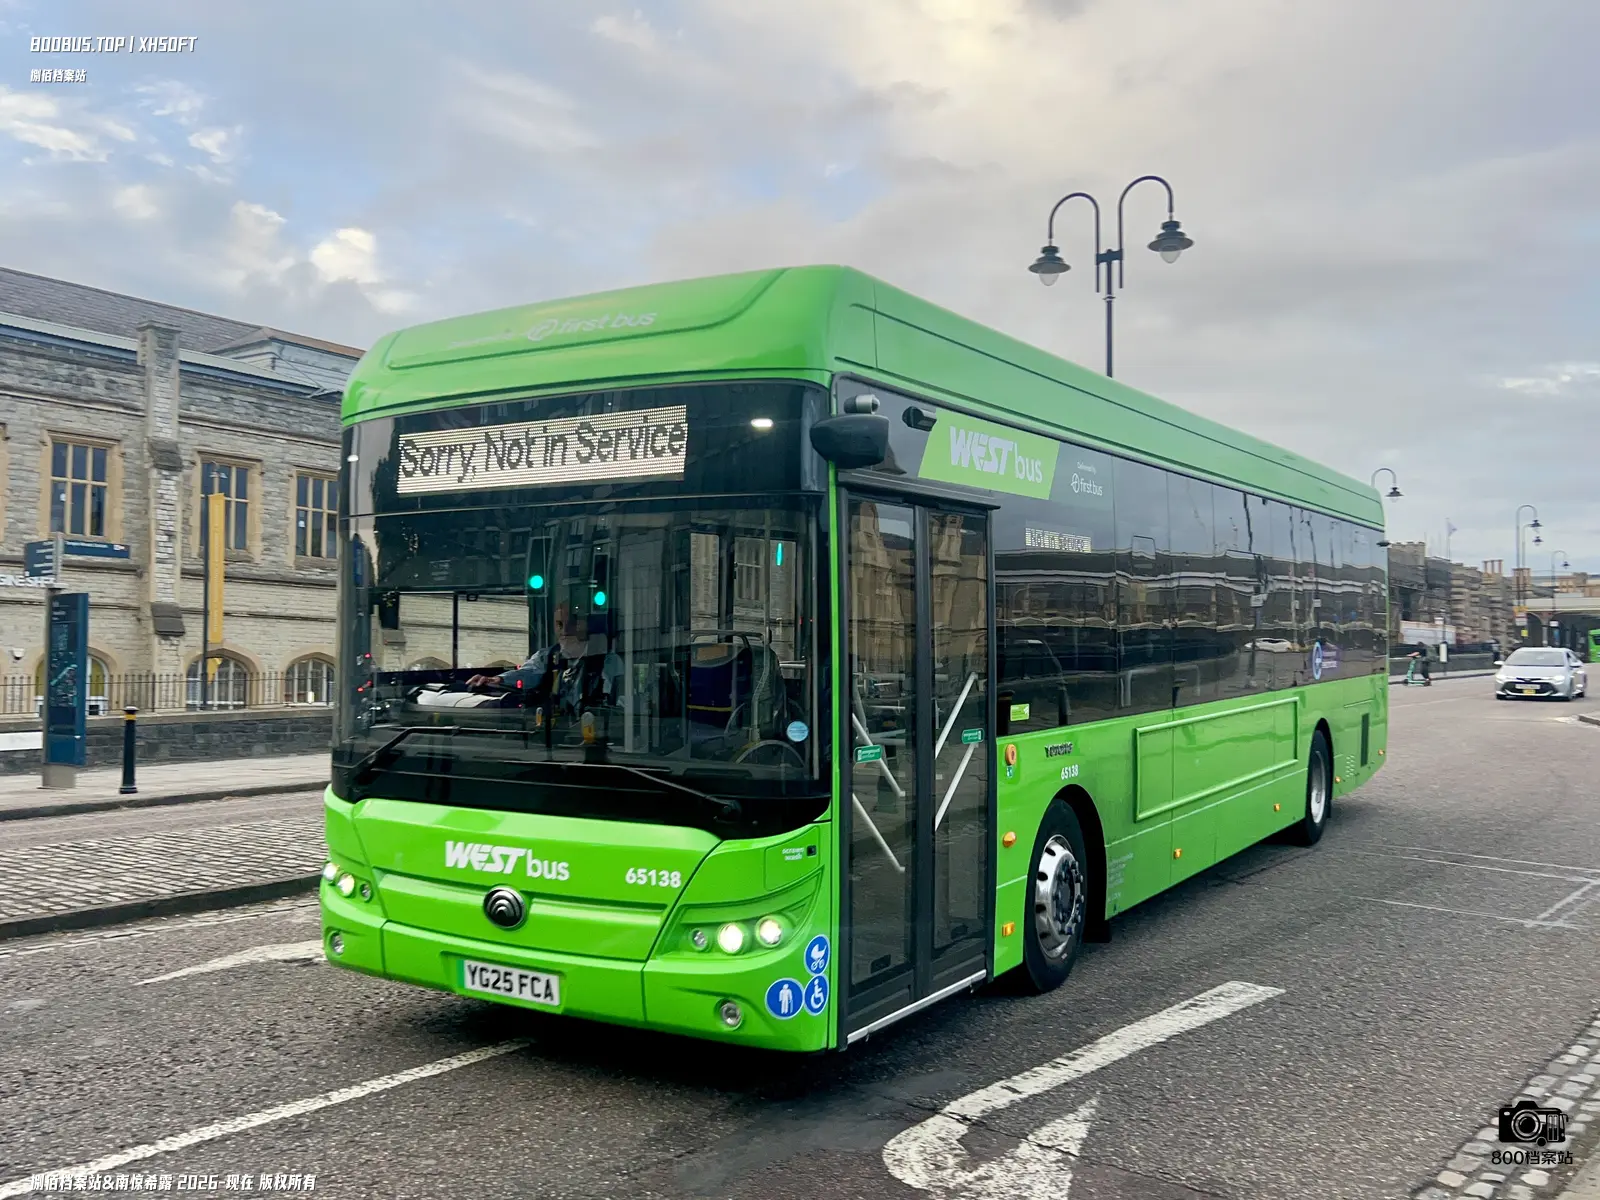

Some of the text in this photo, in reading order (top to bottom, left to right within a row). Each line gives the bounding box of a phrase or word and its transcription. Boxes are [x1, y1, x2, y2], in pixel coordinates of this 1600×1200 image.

[558, 312, 657, 335] first bus
[484, 428, 534, 472] Not
[542, 425, 567, 467] in
[576, 414, 688, 464] Service
[950, 426, 1043, 484] WEST bus
[1061, 764, 1079, 780] 65138
[445, 840, 570, 881] WEST bus
[625, 867, 682, 889] 65138
[467, 964, 555, 1002] YG25 FCA
